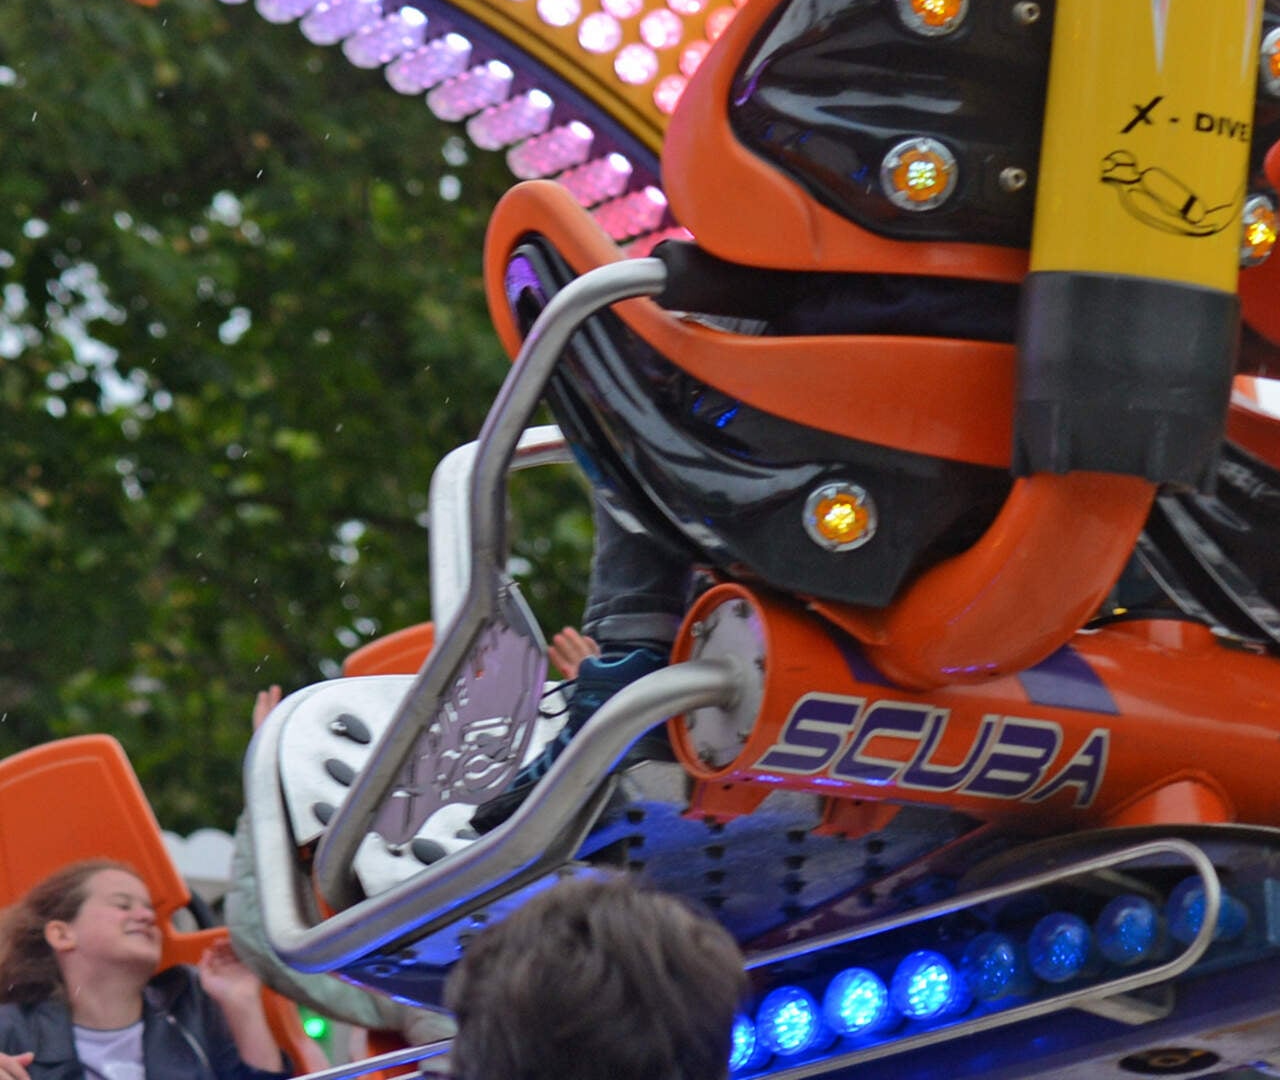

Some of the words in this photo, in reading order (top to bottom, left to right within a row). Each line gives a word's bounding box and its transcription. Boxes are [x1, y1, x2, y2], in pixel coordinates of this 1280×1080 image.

[1119, 96, 1164, 134] X
[1194, 112, 1250, 142] DIVE
[751, 691, 1110, 808] SCUBA
